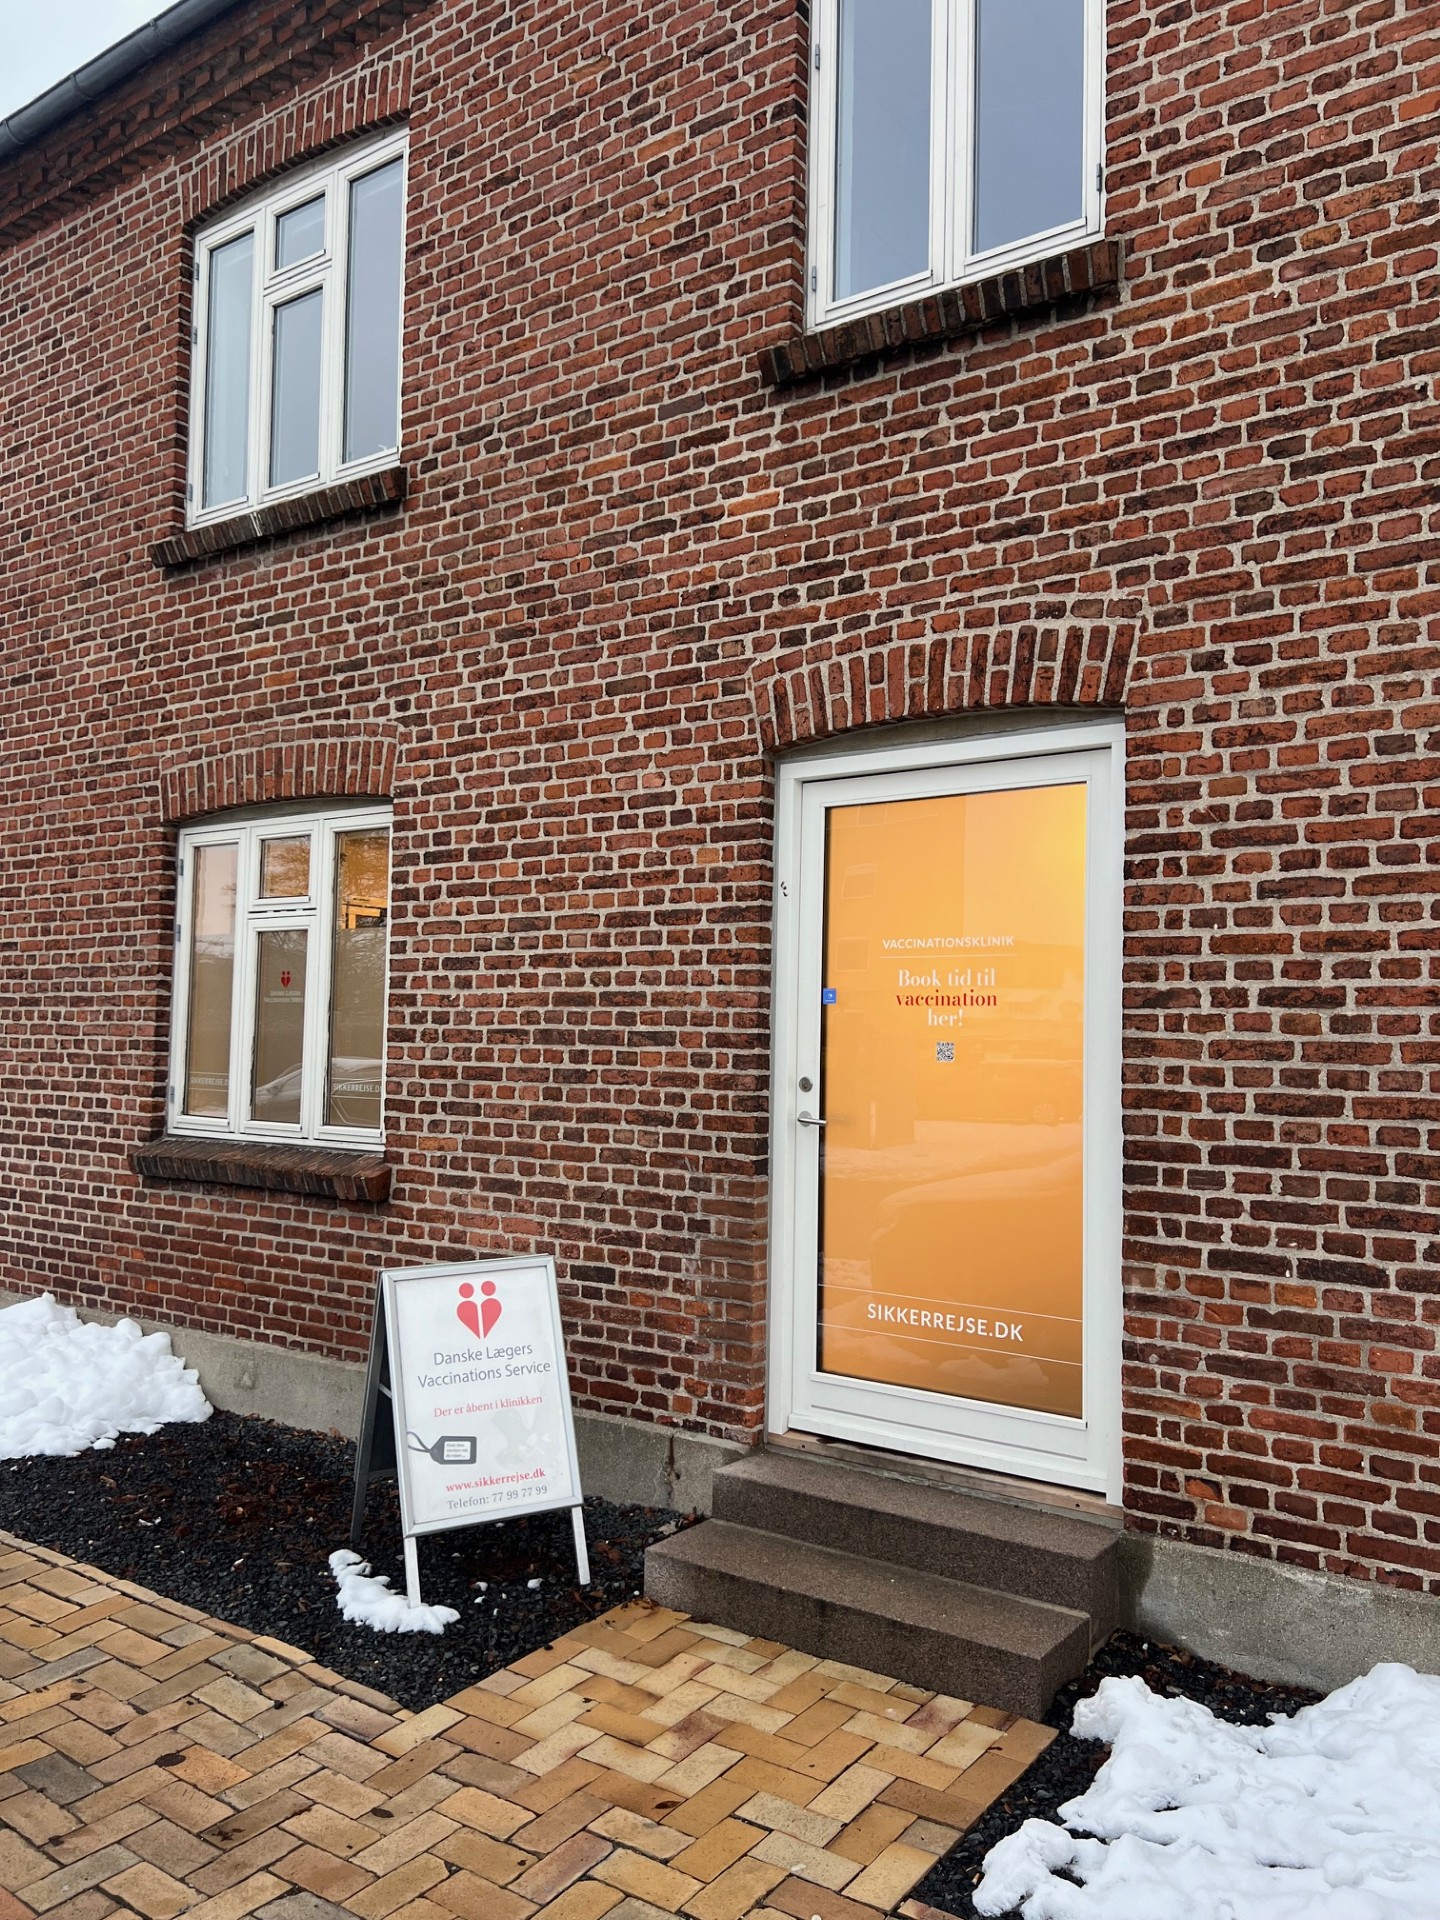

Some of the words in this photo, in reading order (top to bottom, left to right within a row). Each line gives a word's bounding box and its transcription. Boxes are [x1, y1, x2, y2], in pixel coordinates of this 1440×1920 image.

[882, 936, 1014, 949] VACCINATIONSKLINIK
[898, 969, 941, 987] Book
[947, 968, 971, 987] tid
[977, 968, 996, 987] til
[896, 989, 998, 1007] vaccination
[927, 1008, 963, 1027] her!
[867, 1303, 1024, 1342] SIKKERREJSE.DK
[433, 1348, 483, 1366] Danske
[486, 1344, 533, 1360] Lægers
[417, 1368, 502, 1388] Vaccinations
[505, 1361, 551, 1378] Service
[434, 1407, 452, 1417] Der
[454, 1406, 464, 1415] er
[466, 1401, 493, 1413] åbent
[499, 1395, 543, 1409] klinikken
[446, 1468, 546, 1492] www.sikkerrejse.dk
[447, 1496, 489, 1510] Telefon:
[492, 1492, 504, 1503] 77
[506, 1489, 519, 1500] 99
[521, 1487, 533, 1498] 77
[535, 1485, 548, 1496] 99
